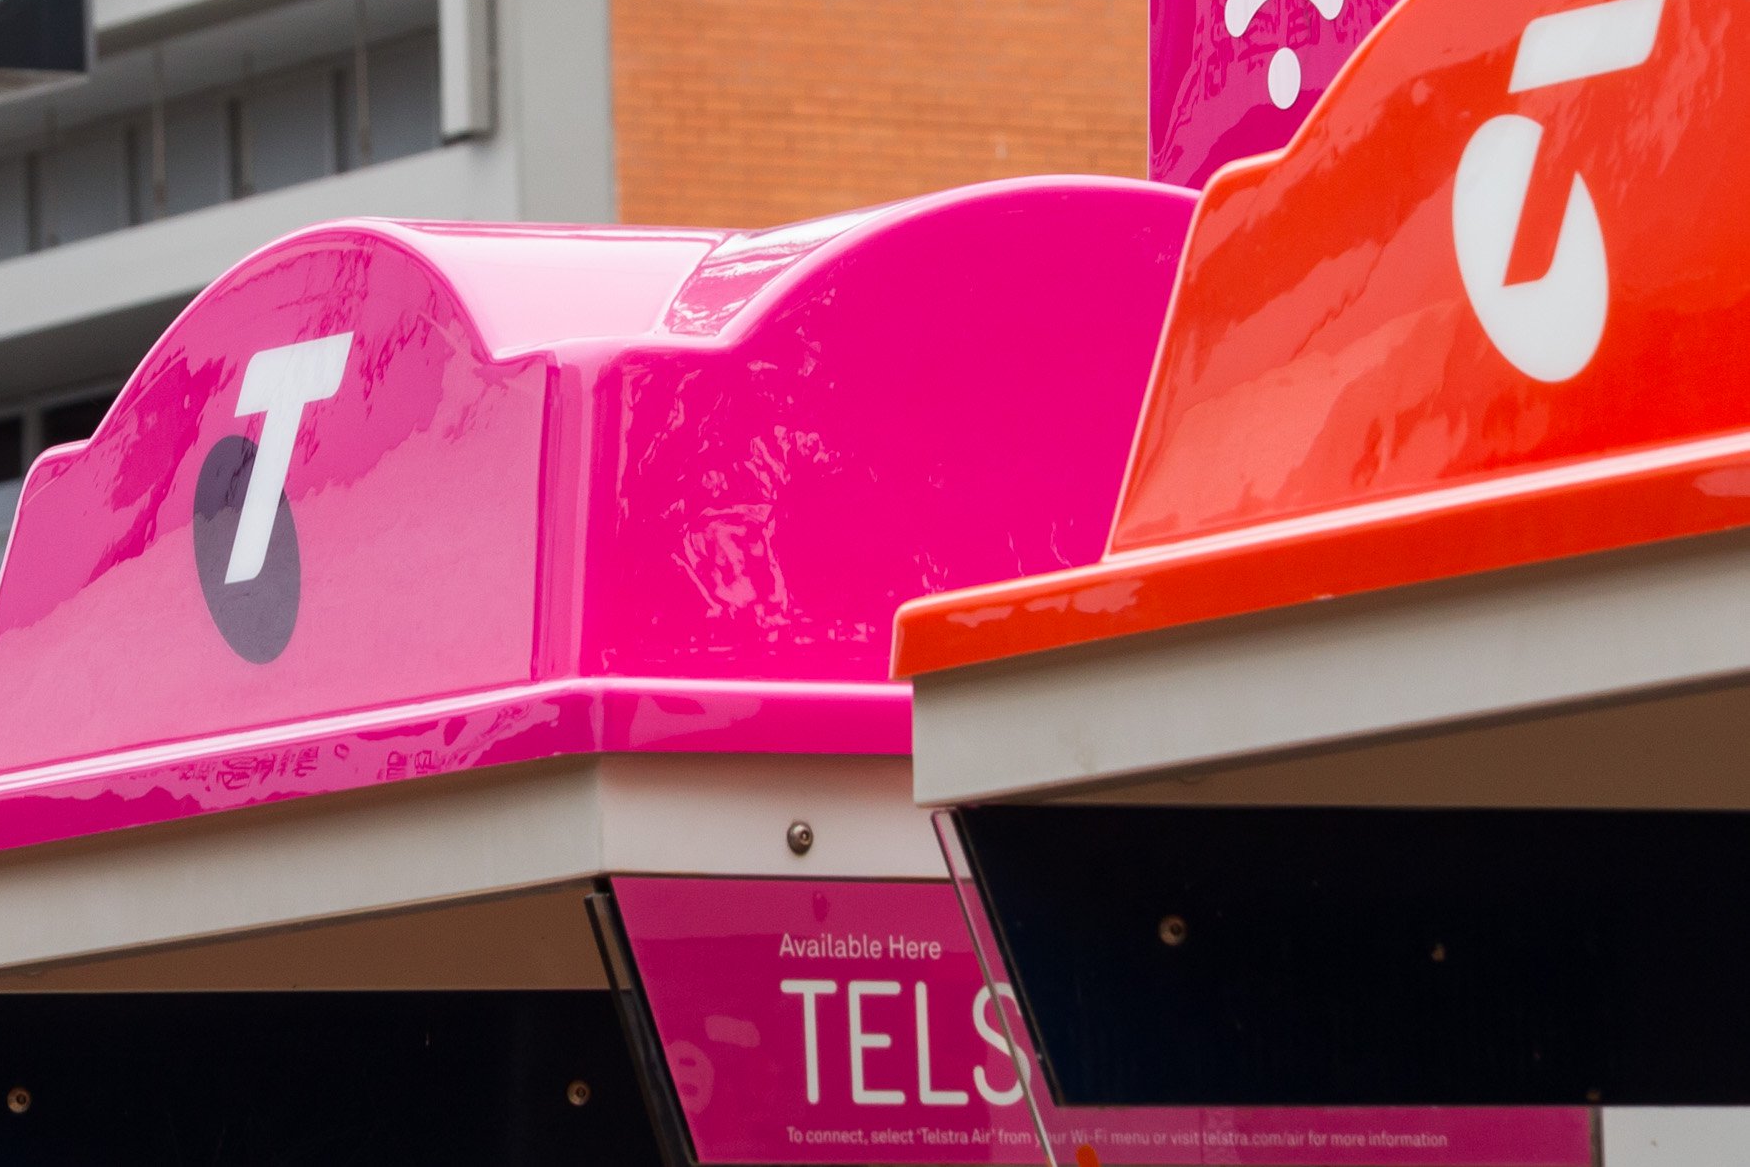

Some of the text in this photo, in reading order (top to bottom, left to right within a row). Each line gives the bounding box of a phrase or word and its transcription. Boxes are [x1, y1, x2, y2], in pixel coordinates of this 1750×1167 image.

[779, 933, 942, 960] Available Here
[780, 979, 1032, 1106] TELS
[786, 1126, 803, 1144] To
[805, 1128, 869, 1146] connect,
[870, 1128, 914, 1144] select
[999, 1128, 1031, 1144] from
[1071, 1128, 1107, 1144] Wi-Fi
[1111, 1132, 1150, 1145] menu
[1153, 1133, 1167, 1145] or
[1170, 1129, 1199, 1145] visit
[1203, 1129, 1304, 1147] telstra.com/air
[1308, 1129, 1327, 1145] for
[1330, 1133, 1366, 1146] more
[1369, 1130, 1448, 1147] information
